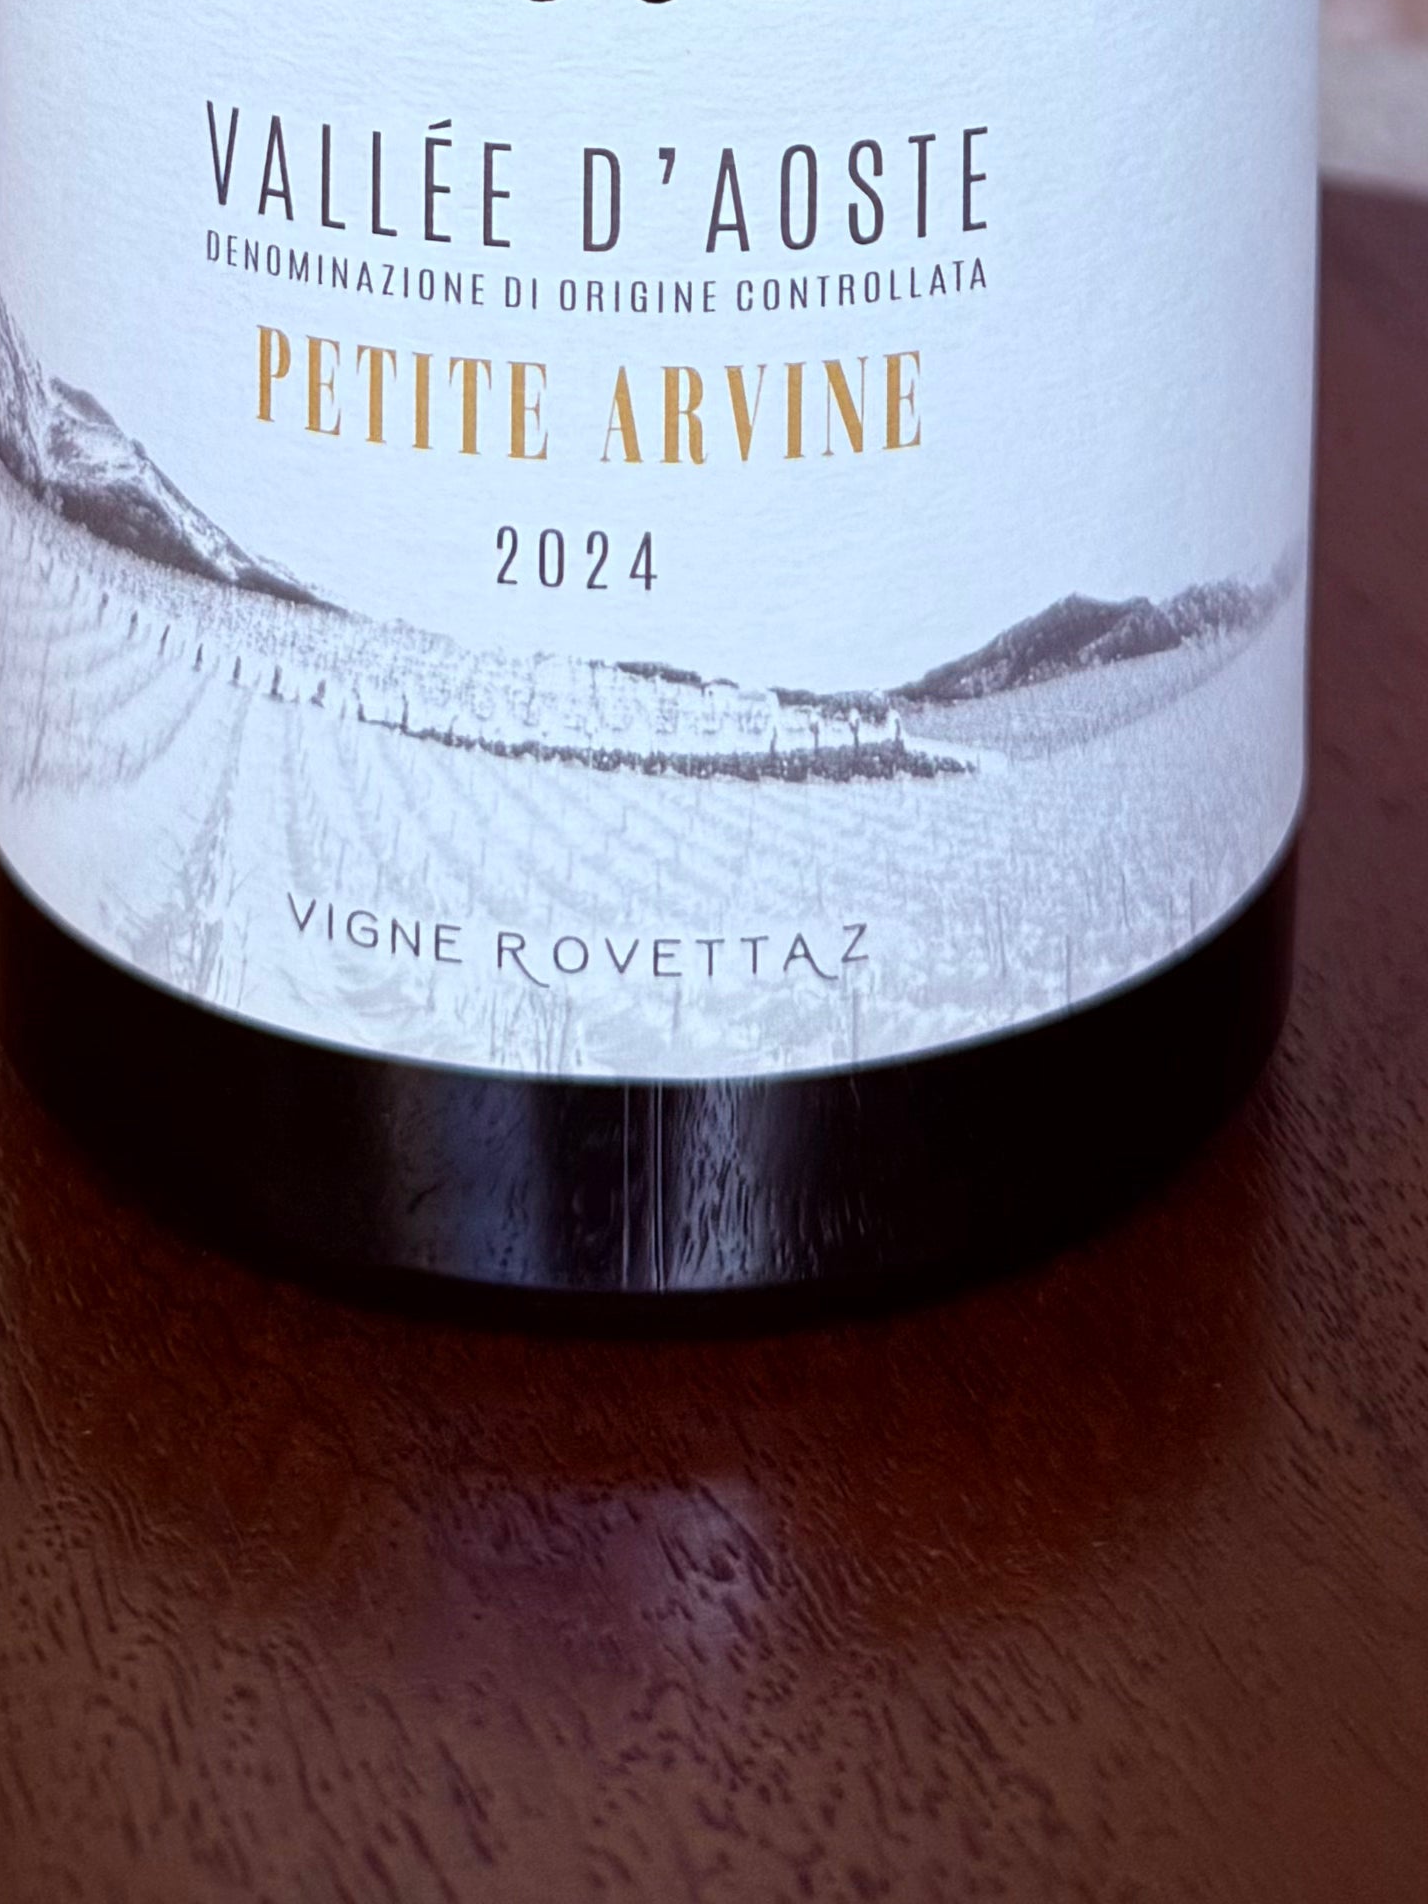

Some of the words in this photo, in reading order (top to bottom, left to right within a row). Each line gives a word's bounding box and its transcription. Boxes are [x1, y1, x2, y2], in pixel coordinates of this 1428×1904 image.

[206, 99, 513, 249] VALLÉE
[582, 125, 989, 254] D’AOSTE
[206, 229, 485, 308] DENOMINAZIONE
[504, 275, 538, 311] DI
[559, 279, 717, 314] ORIGINE
[736, 256, 988, 313] CONTROLLATA
[255, 324, 550, 462] PETITE
[600, 349, 922, 467] ARVINE
[496, 525, 658, 592] 2024
[287, 892, 463, 964] VIGNE
[497, 923, 869, 989] ROVETTAZ
